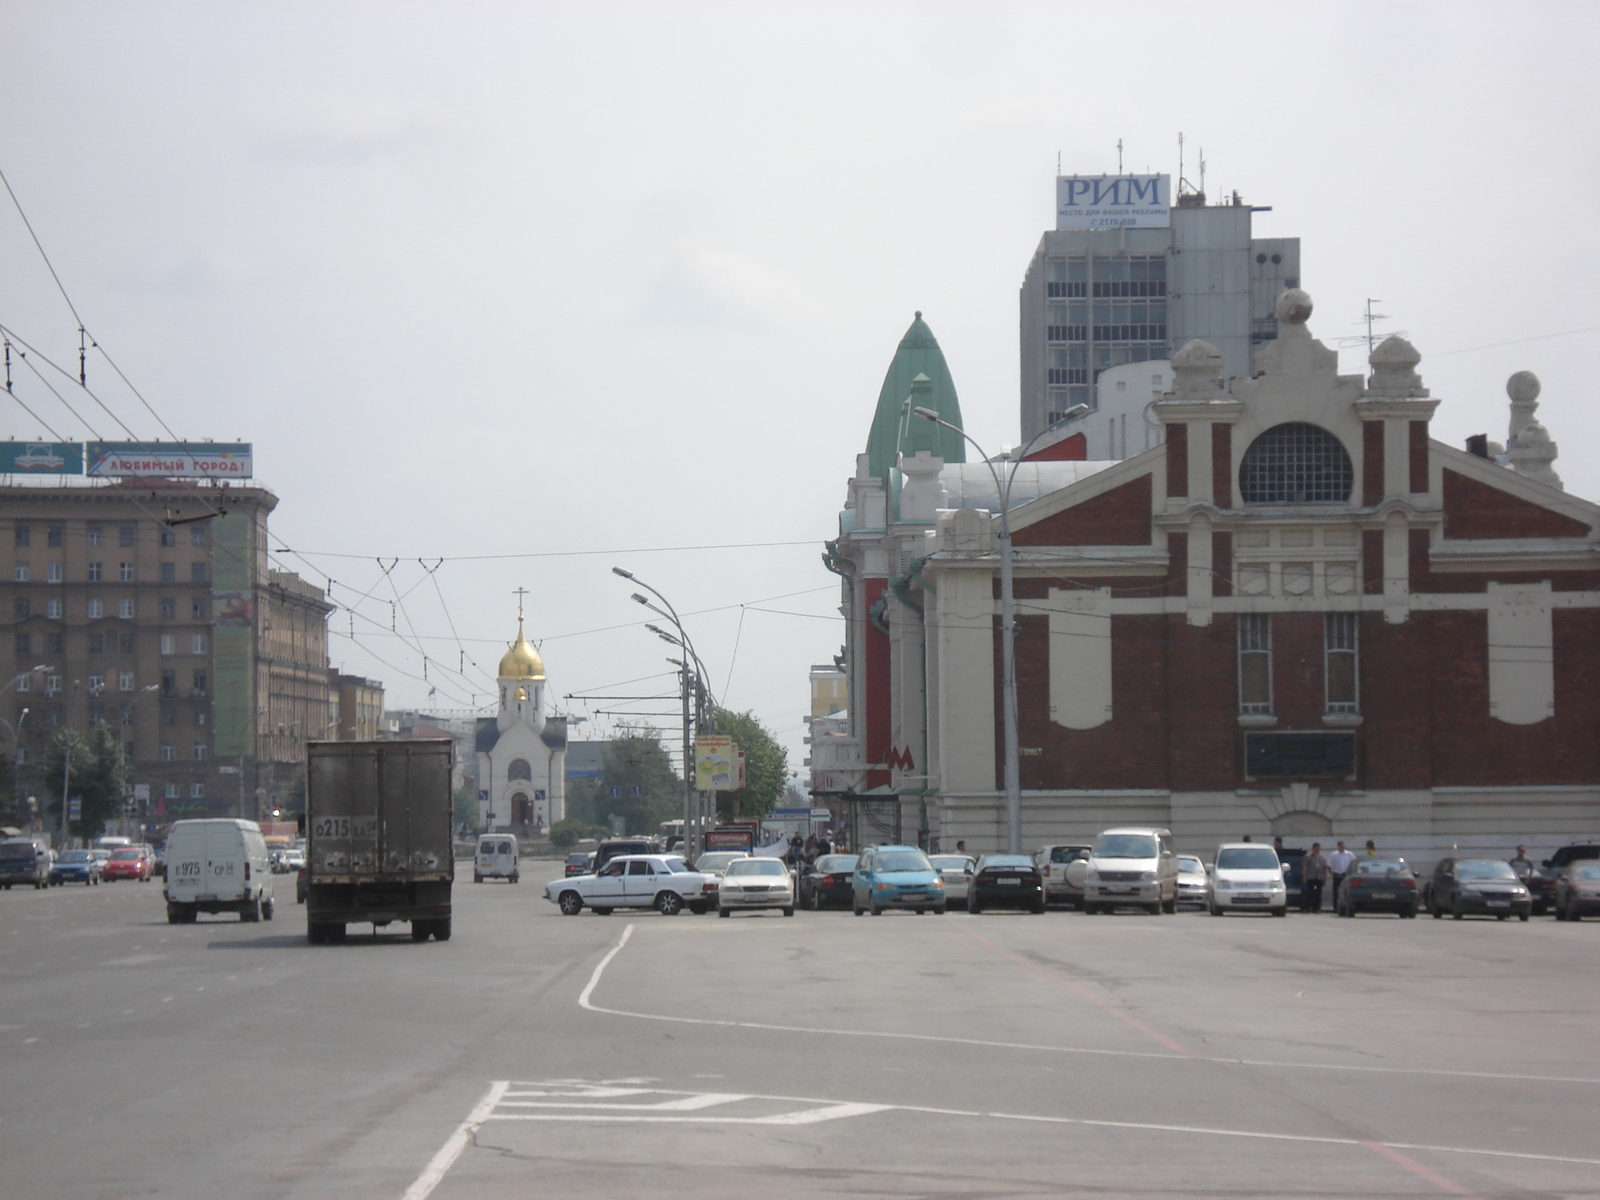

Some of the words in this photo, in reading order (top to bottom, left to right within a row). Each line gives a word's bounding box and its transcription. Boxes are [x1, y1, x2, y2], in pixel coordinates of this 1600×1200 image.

[1064, 178, 1162, 206] РИМ
[110, 459, 184, 471] ЛЮБИМЫЙ
[193, 461, 245, 471] ГОРОД!
